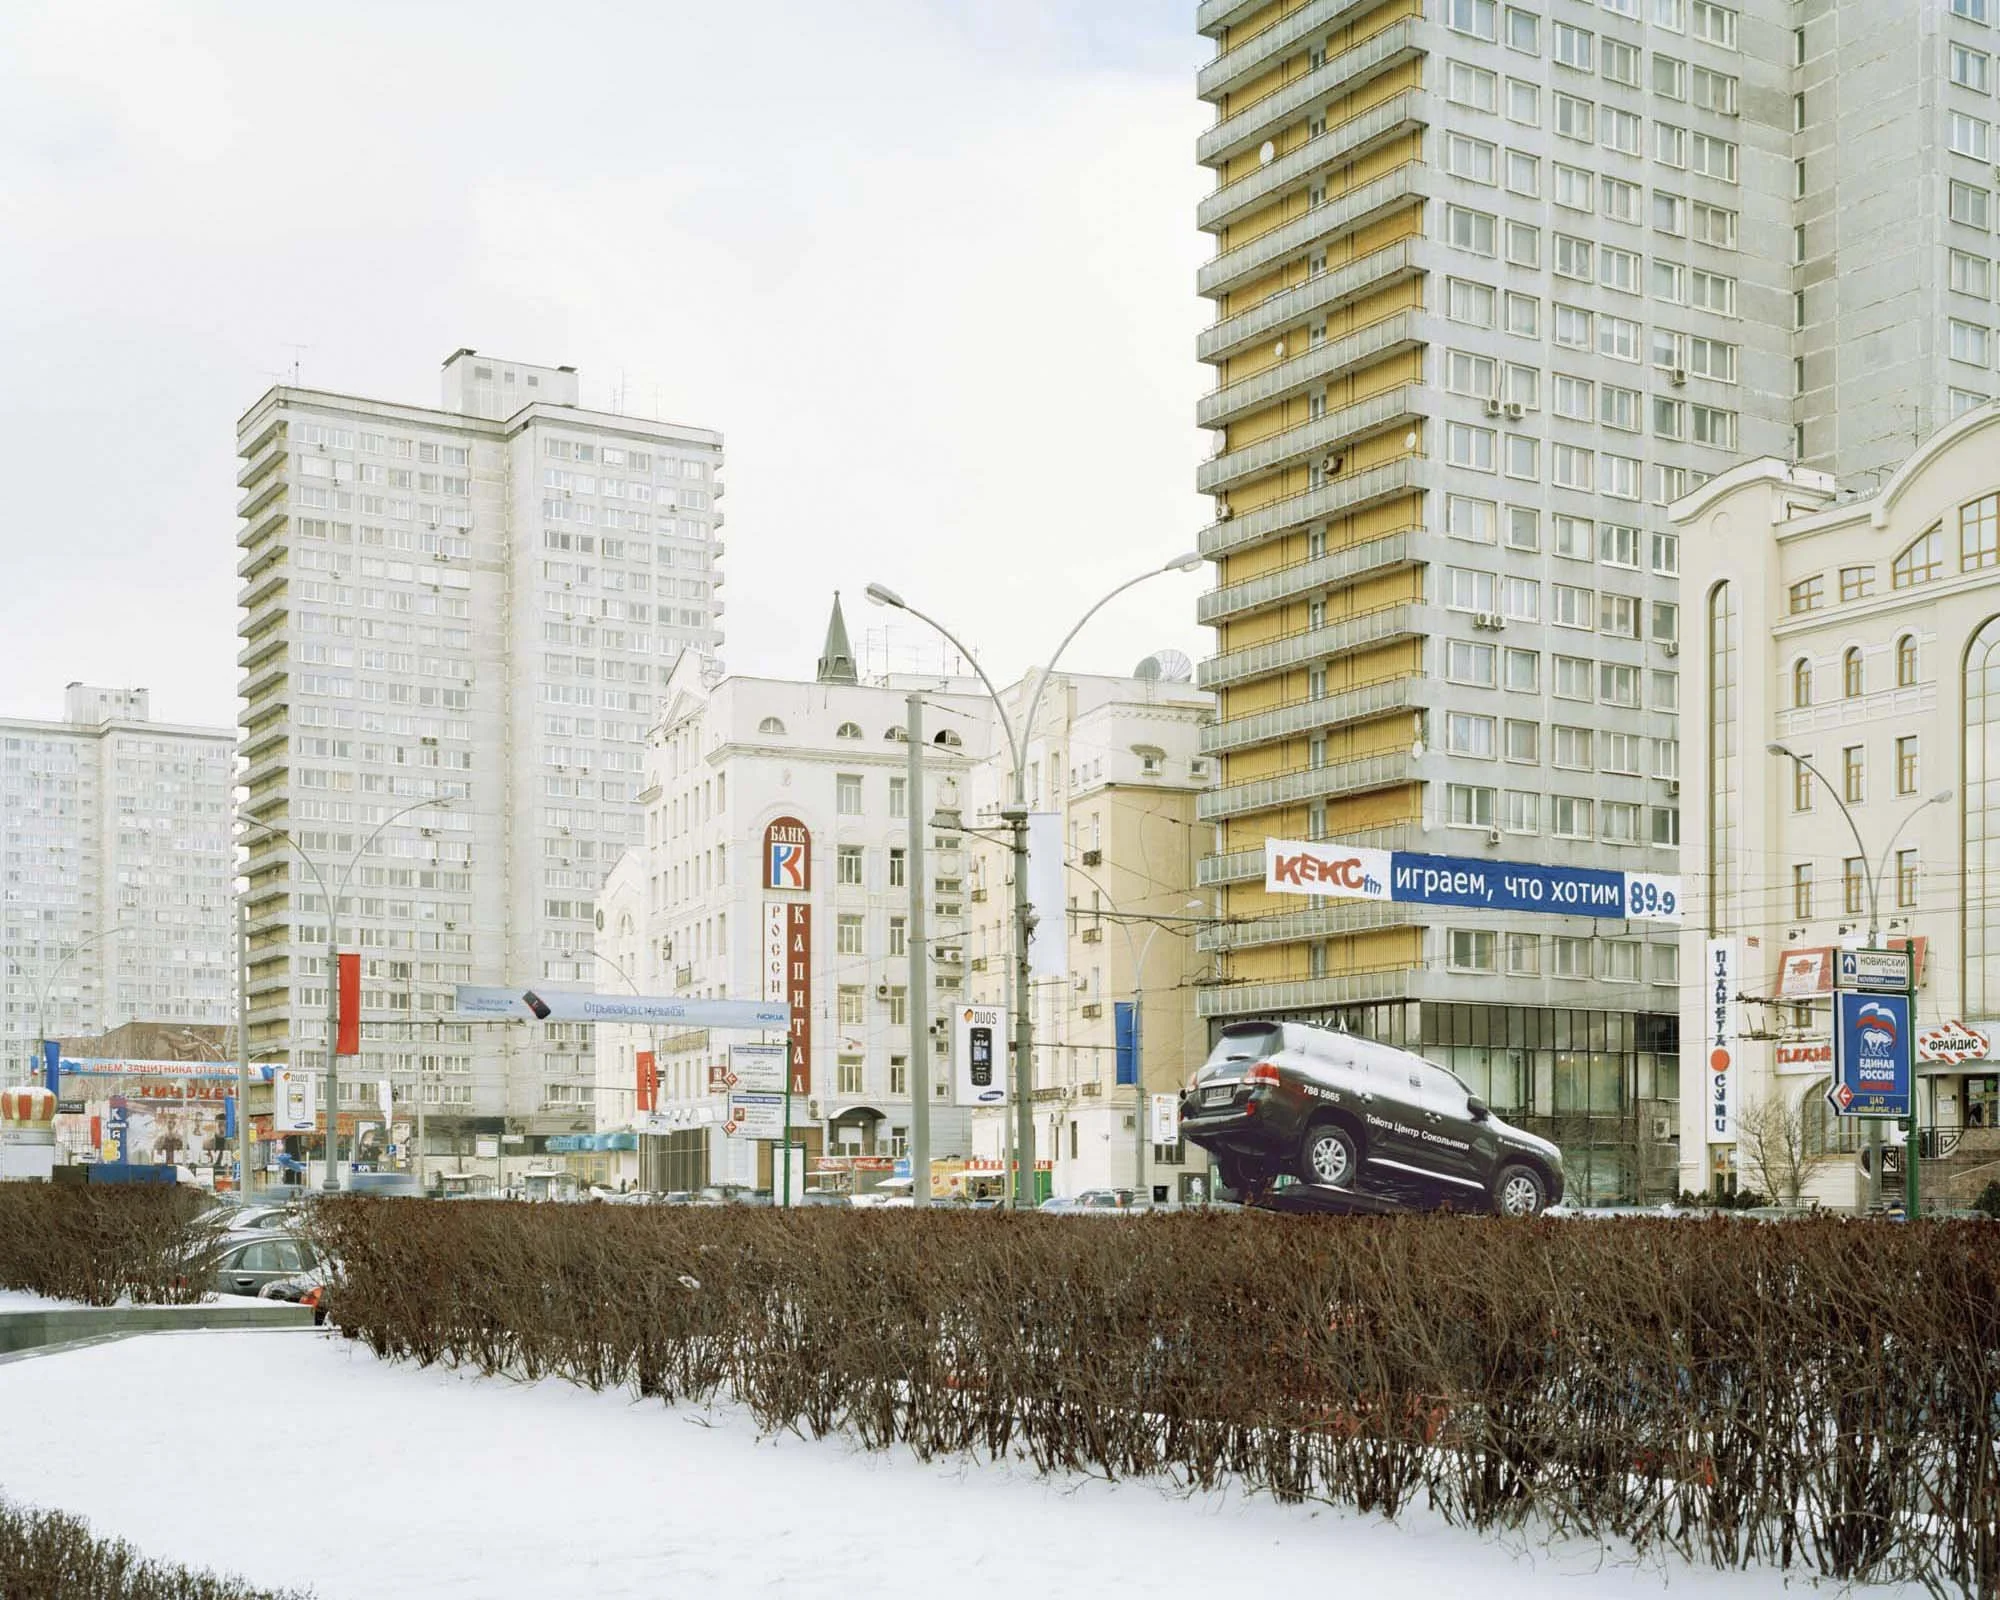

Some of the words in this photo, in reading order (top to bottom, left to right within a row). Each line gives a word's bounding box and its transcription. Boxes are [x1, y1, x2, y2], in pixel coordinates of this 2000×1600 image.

[771, 826, 805, 842] БАНК
[1275, 853, 1364, 889] КЕКС
[1396, 867, 1493, 902] играем,
[1505, 875, 1543, 900] что
[1551, 880, 1619, 906] хотим
[1630, 881, 1675, 914] 89.9
[793, 905, 805, 1093] КАПИТАЛ
[1714, 949, 1727, 1046] ПЛАНЕТА
[757, 1013, 784, 1021] NOKIA
[975, 1012, 997, 1024] DUOS
[1929, 1038, 1978, 1051] ФРАЙДИС
[127, 1064, 193, 1075] ЗАЩИТНИКА
[195, 1065, 256, 1077] ОТЕЧЕСТА!
[1859, 1058, 1894, 1069] ЕДИНАЯ
[1859, 1070, 1894, 1080] РОССИЯ
[1366, 1113, 1393, 1130] Тойота
[1394, 1123, 1420, 1138] Центр
[1421, 1130, 1470, 1151] Сокольники
